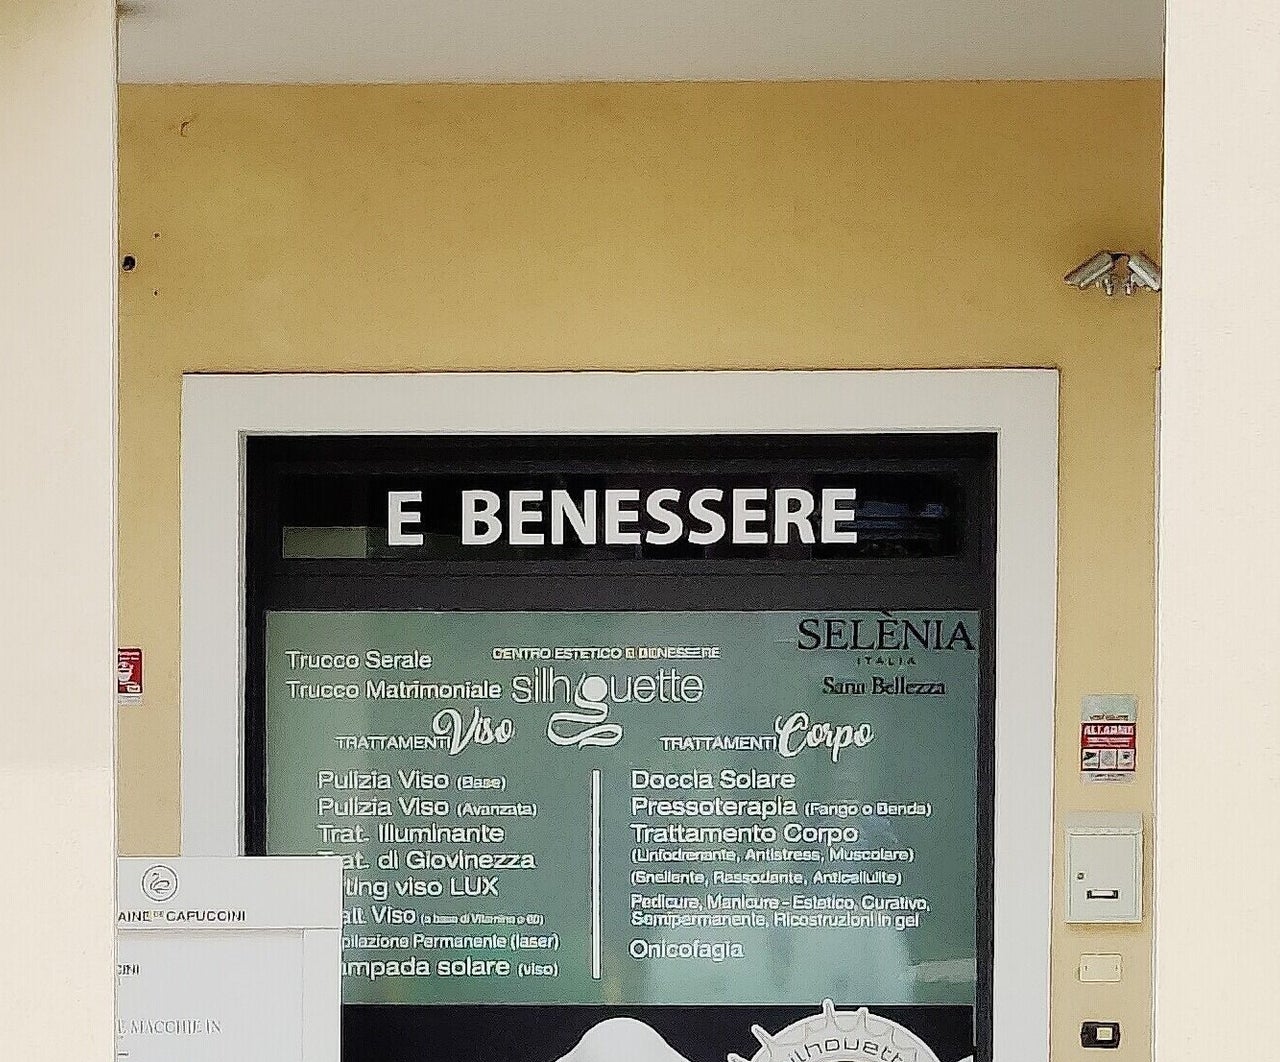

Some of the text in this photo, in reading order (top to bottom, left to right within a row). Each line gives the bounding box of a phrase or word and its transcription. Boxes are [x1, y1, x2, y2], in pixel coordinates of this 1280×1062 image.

[386, 489, 857, 546] E BENESSERE
[797, 610, 977, 651] SELÈNIA
[285, 650, 433, 669] Trucco Serale
[492, 647, 552, 660] CENTRO
[555, 647, 622, 660] ESTETICO
[285, 680, 503, 700] Trucco Matrimoniale
[871, 676, 946, 695] Bellezza
[334, 707, 517, 757] TRATTAMENTI Viso
[659, 712, 875, 763] TRATTAMENTI Corpo
[318, 769, 507, 791] Pulizia Viso (Base)
[630, 770, 796, 789] Doccia Solare
[318, 796, 539, 818] Pulizia Viso (Avanzata)
[631, 797, 799, 820] Pressoterapia
[804, 802, 859, 819] (Fango
[861, 805, 873, 816] o
[317, 822, 506, 843] Trat. Illuminante
[630, 824, 860, 847] Trattamento Corpo
[378, 849, 400, 870] di
[405, 850, 536, 870] Giovinezza
[744, 848, 826, 863] Antistress,
[829, 848, 916, 862] Muscolare)
[394, 877, 444, 896] viso
[449, 877, 500, 896] LUX
[706, 894, 780, 910] Manicure
[861, 894, 932, 912] Curativo,
[166, 910, 246, 922] CAPUCCINI
[370, 904, 417, 924] Viso
[773, 912, 874, 928] Ricostruzioni
[894, 913, 919, 931] gel
[413, 933, 507, 949] Permanente
[510, 932, 561, 951] (laser)
[628, 940, 744, 960] Onicofagia
[436, 957, 511, 977] solare
[518, 963, 560, 978] (viso)
